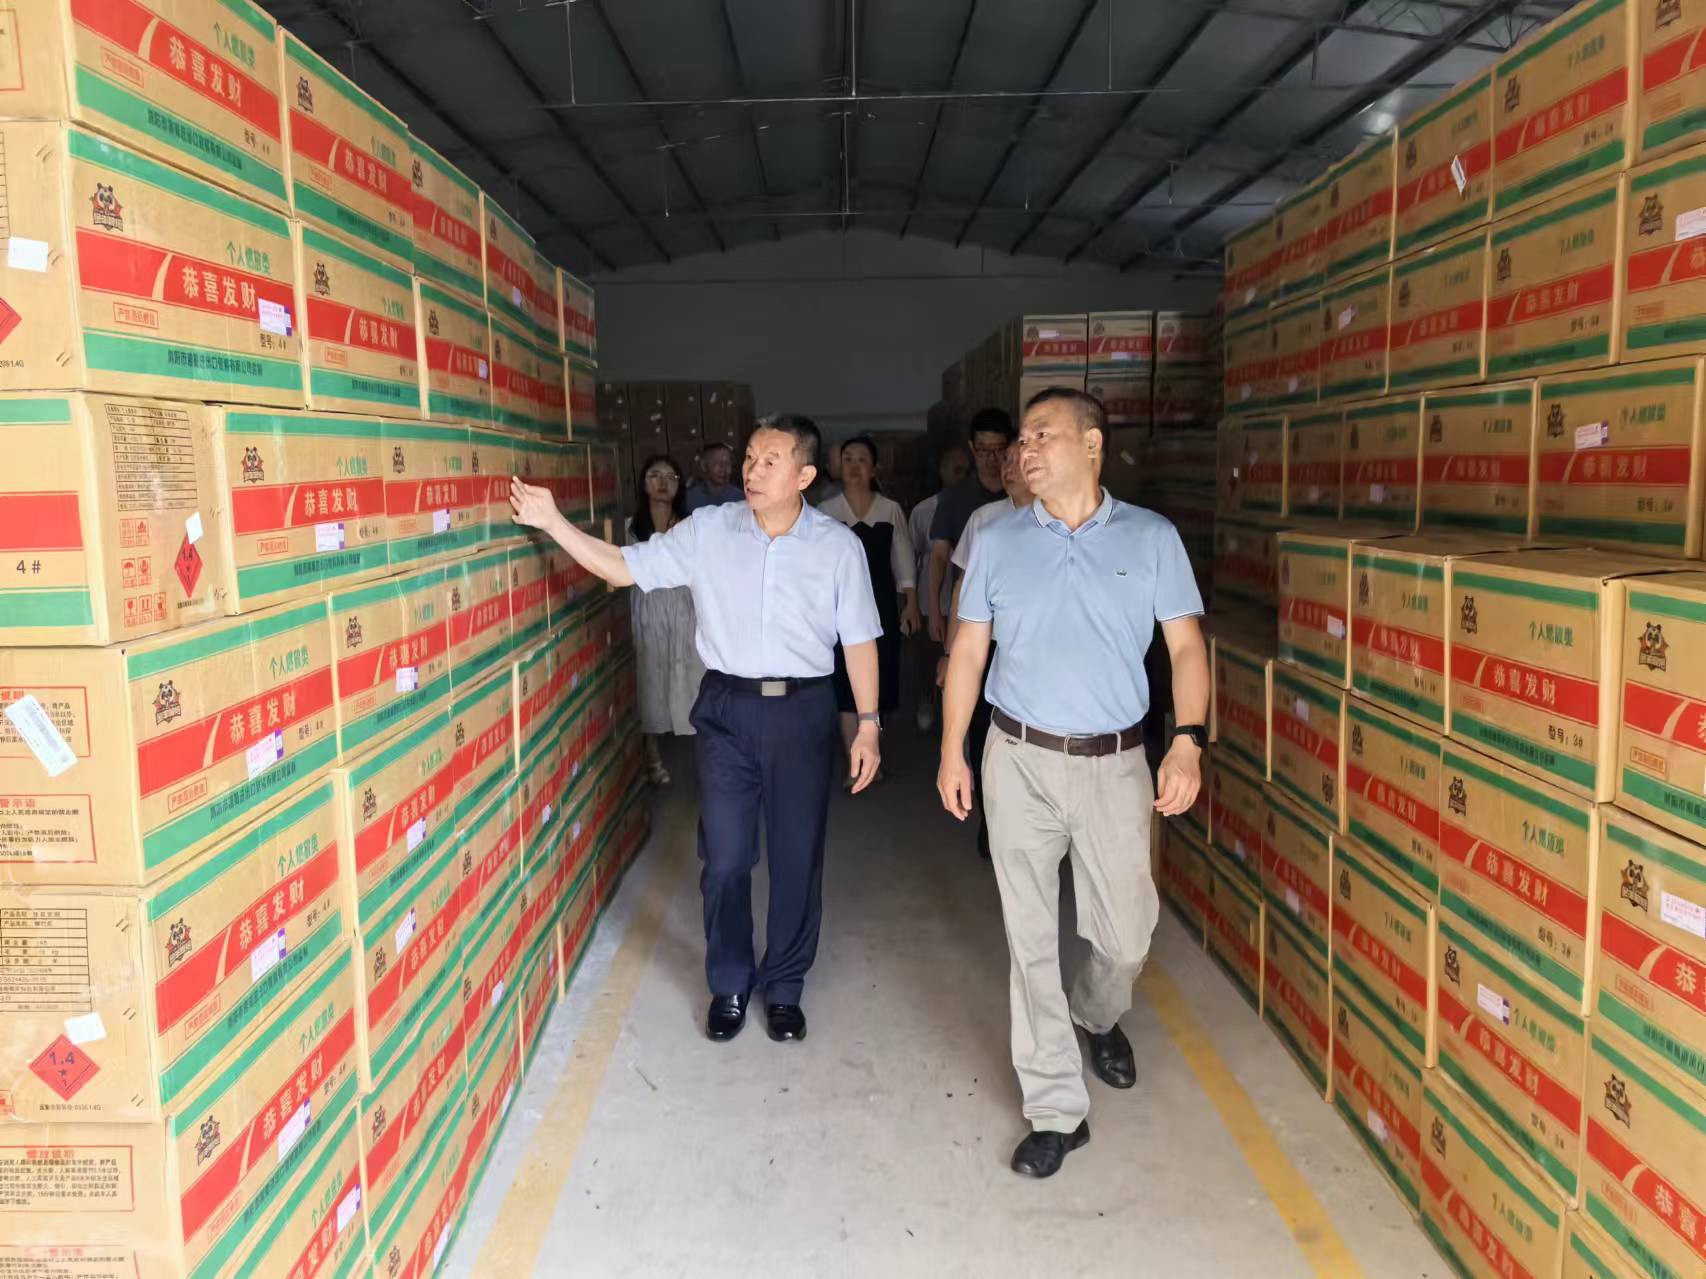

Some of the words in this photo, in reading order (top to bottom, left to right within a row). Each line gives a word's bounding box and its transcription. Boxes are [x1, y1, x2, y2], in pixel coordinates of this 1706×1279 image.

[168, 35, 243, 108] 恭喜发财
[181, 265, 256, 313] 恭喜发财
[1583, 455, 1647, 480] 恭喜发财
[305, 487, 358, 516] 恭喜发财
[1493, 664, 1556, 705] 恭喜发财
[230, 692, 296, 744] 恭喜发财
[1485, 850, 1547, 908] 恭喜发财
[239, 880, 305, 950] 恭喜发财
[1674, 961, 1706, 1003] 恭
[49, 1051, 75, 1065] 1.4
[1479, 1028, 1539, 1096] 恭喜发财
[263, 1052, 323, 1140] 恭喜发财
[1654, 1184, 1706, 1250] 恭喜
